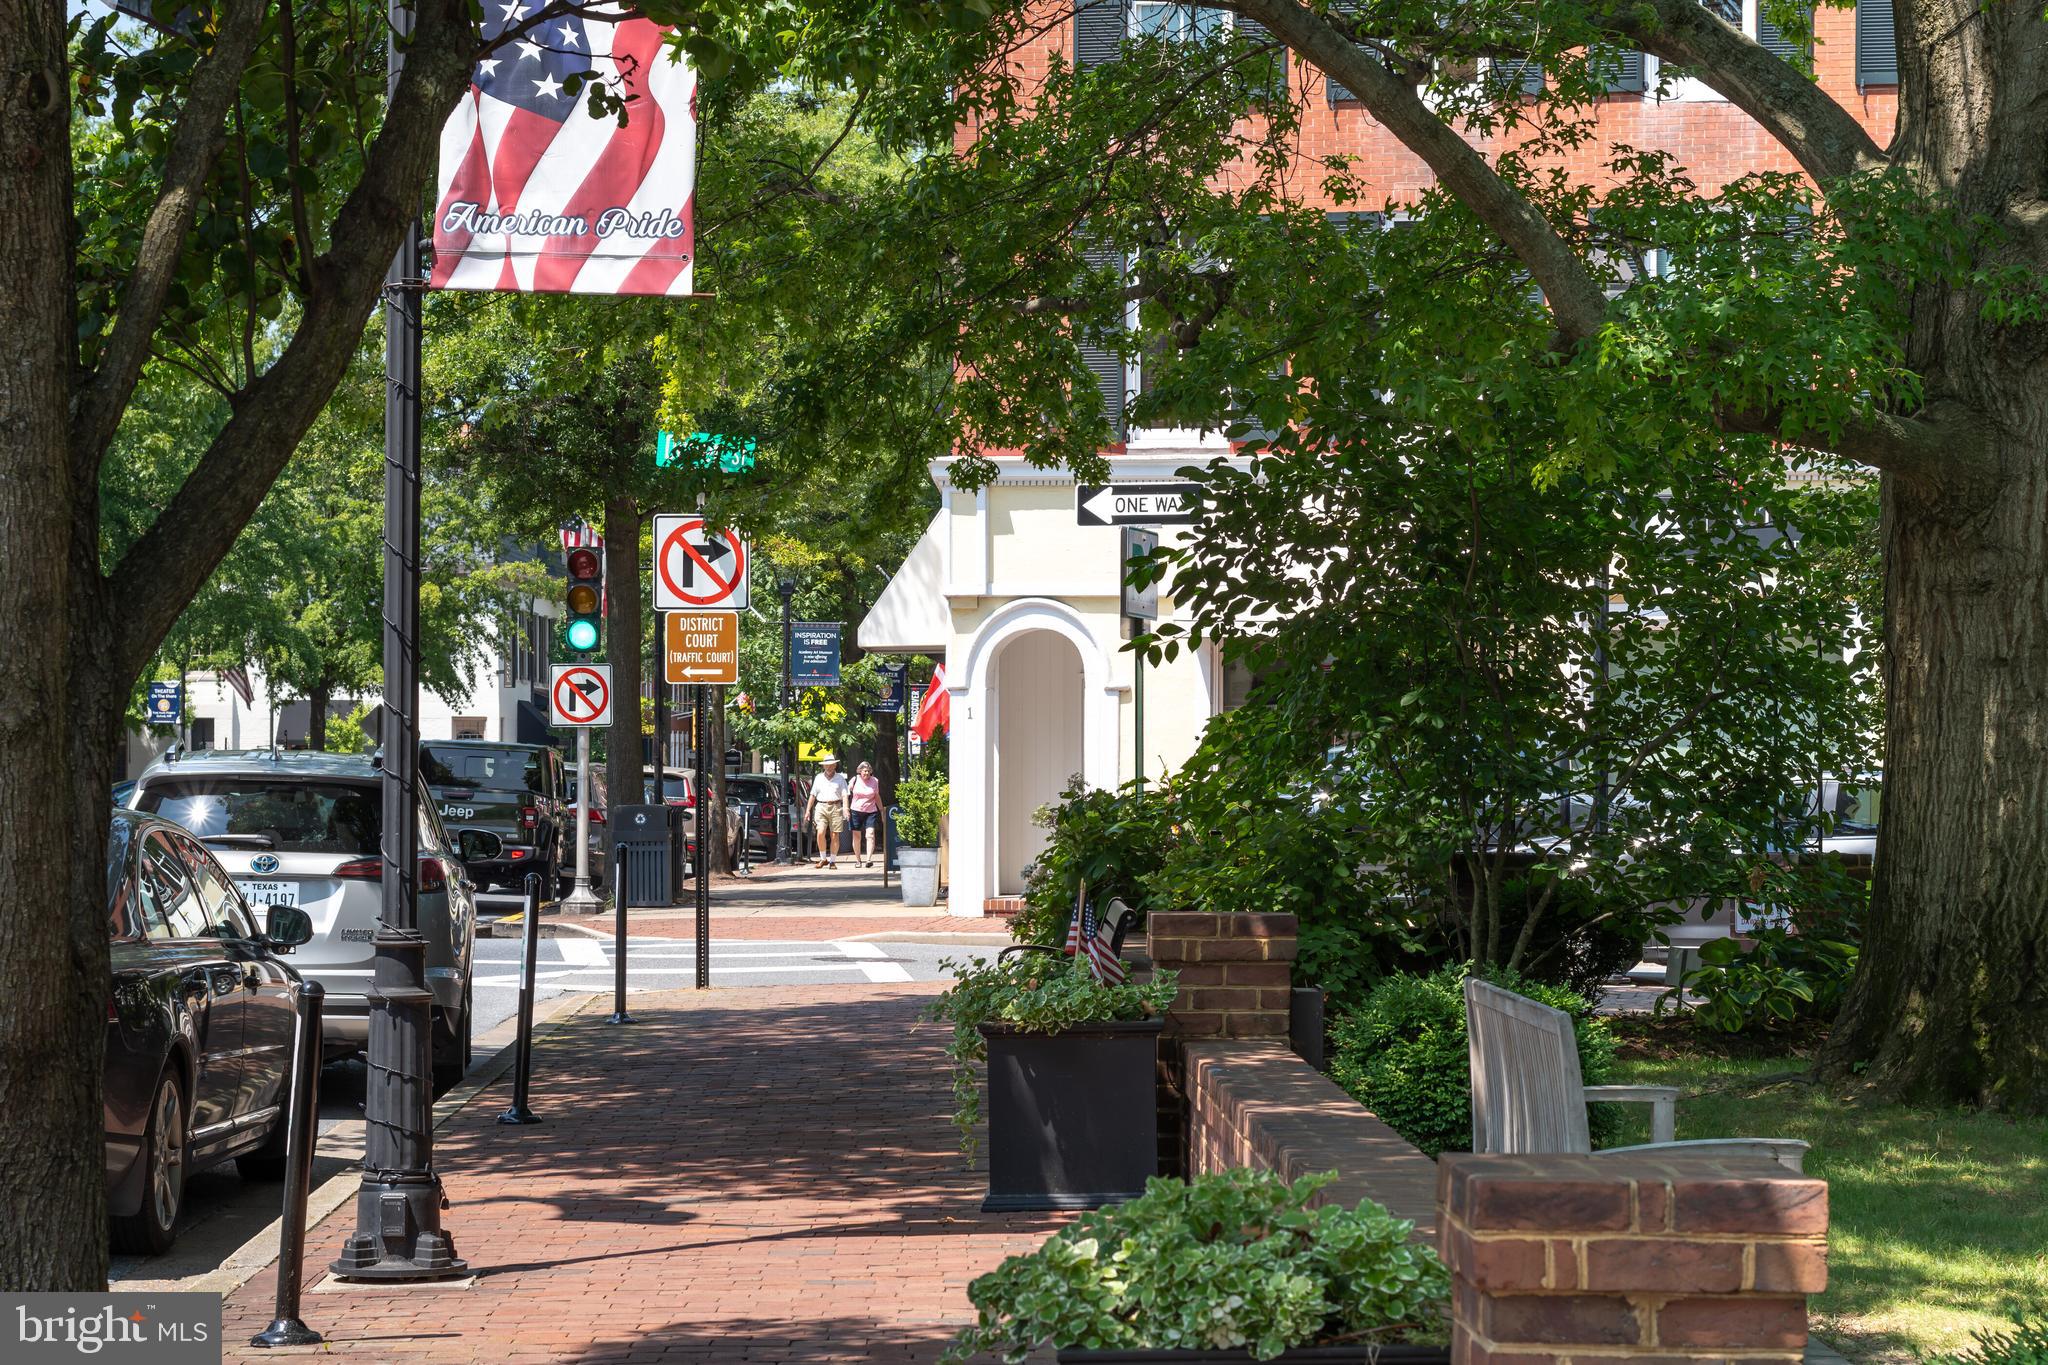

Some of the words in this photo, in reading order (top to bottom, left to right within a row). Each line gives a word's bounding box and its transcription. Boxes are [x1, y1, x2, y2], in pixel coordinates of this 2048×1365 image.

[442, 201, 588, 236] American
[596, 208, 685, 239] Pride
[1115, 497, 1148, 513] ONE
[680, 617, 724, 631] DISTRICT
[685, 633, 718, 648] COURT
[669, 650, 703, 664] (TRAFFIC
[706, 650, 734, 664] COURT)
[967, 706, 974, 720] 1
[438, 804, 474, 819] Jeep
